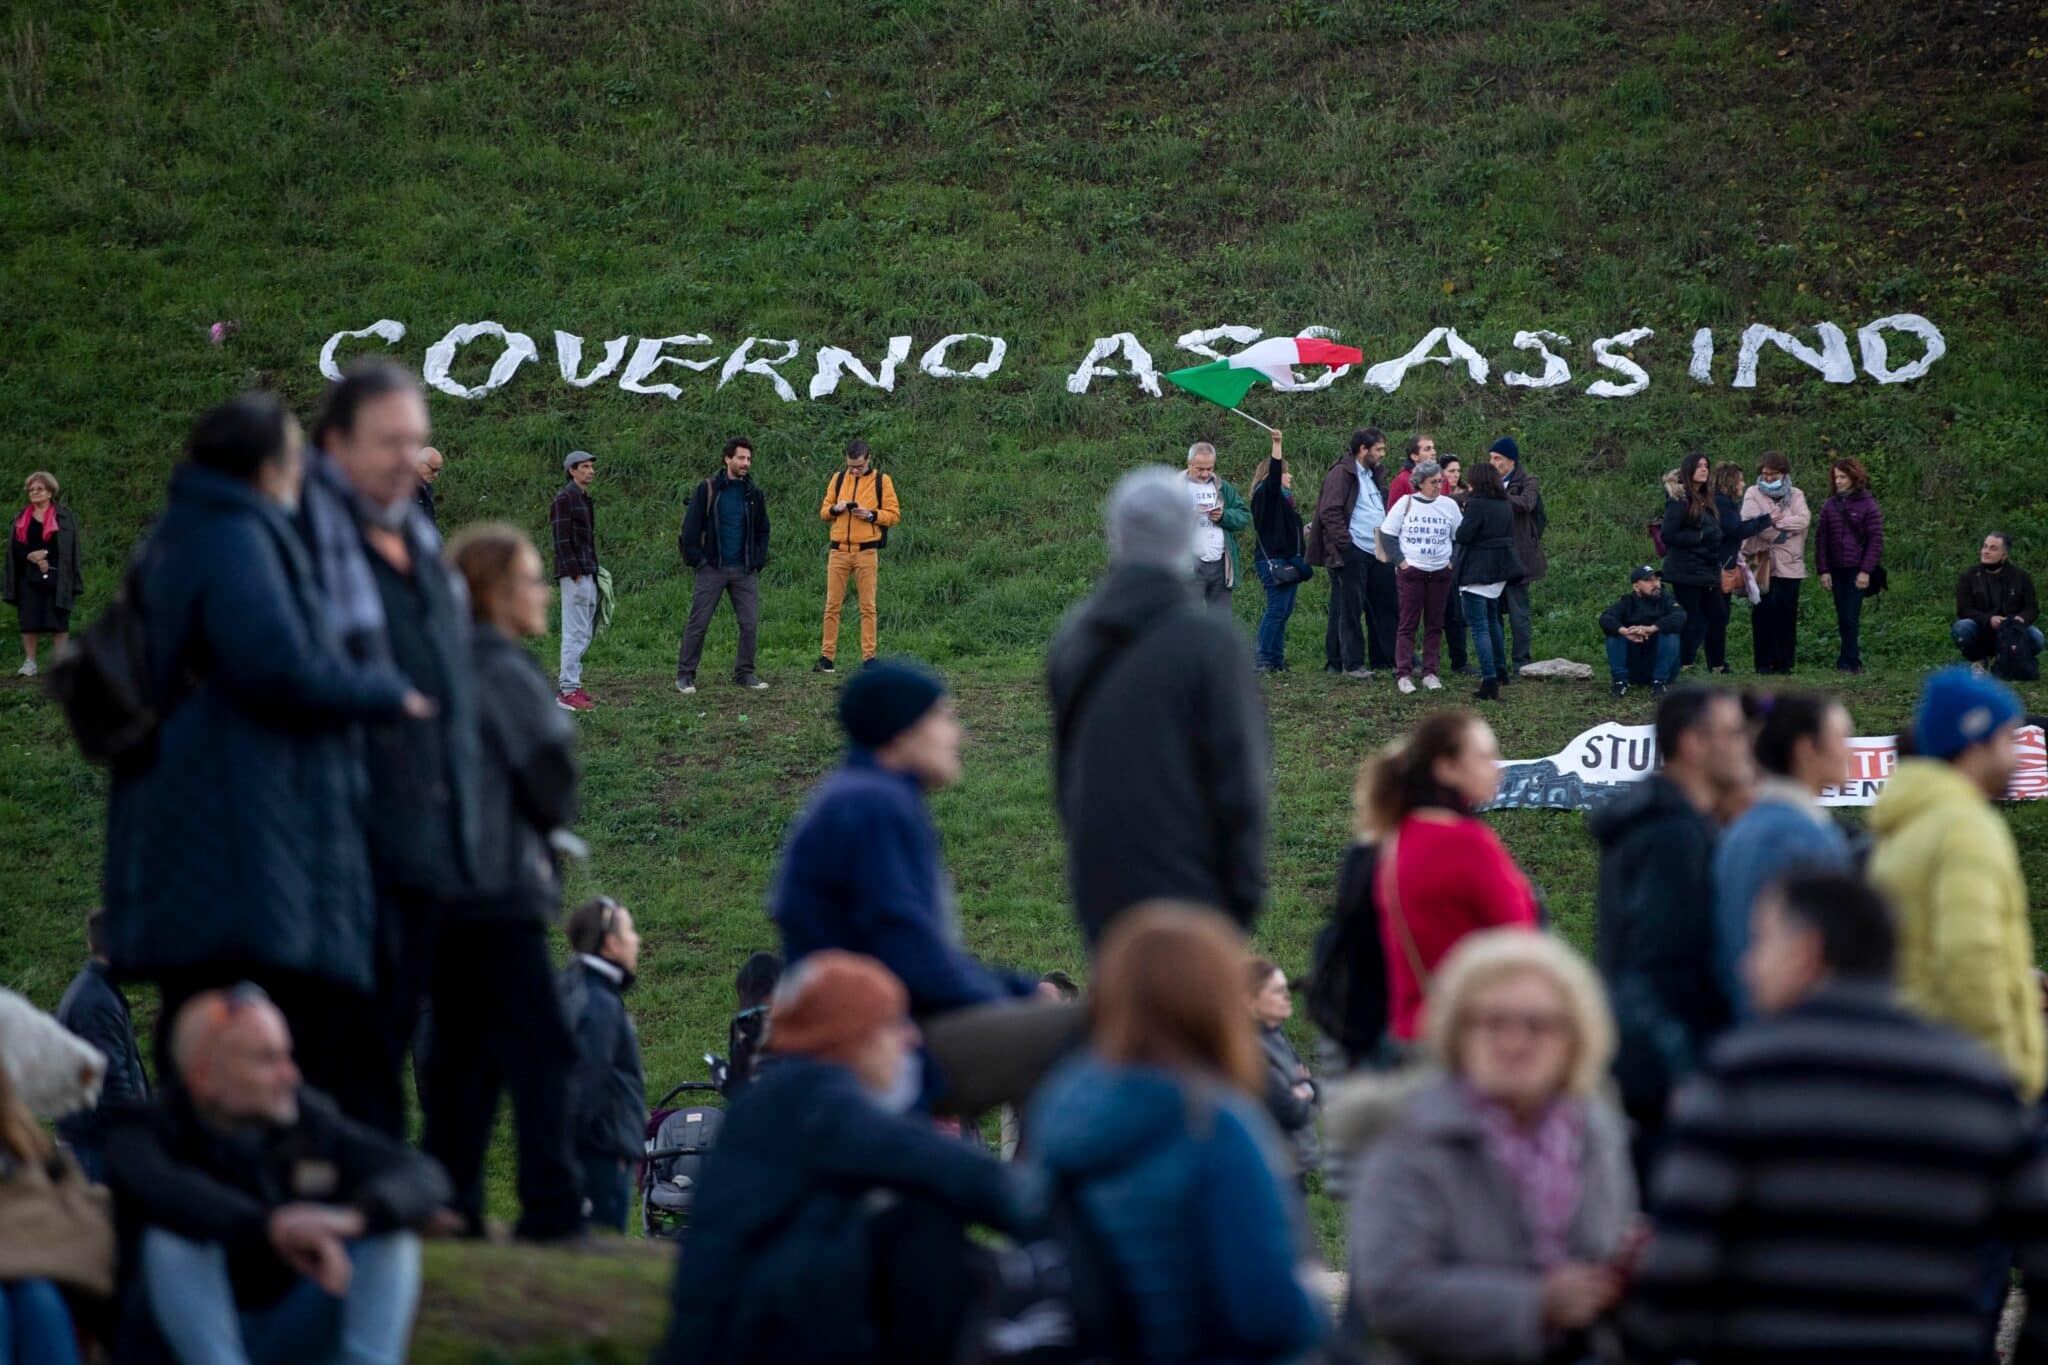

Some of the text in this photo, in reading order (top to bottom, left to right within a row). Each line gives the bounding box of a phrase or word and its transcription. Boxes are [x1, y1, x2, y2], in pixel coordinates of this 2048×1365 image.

[1421, 516, 1447, 524] GENTE
[1408, 526, 1430, 534] COME
[1406, 537, 1422, 545] NON
